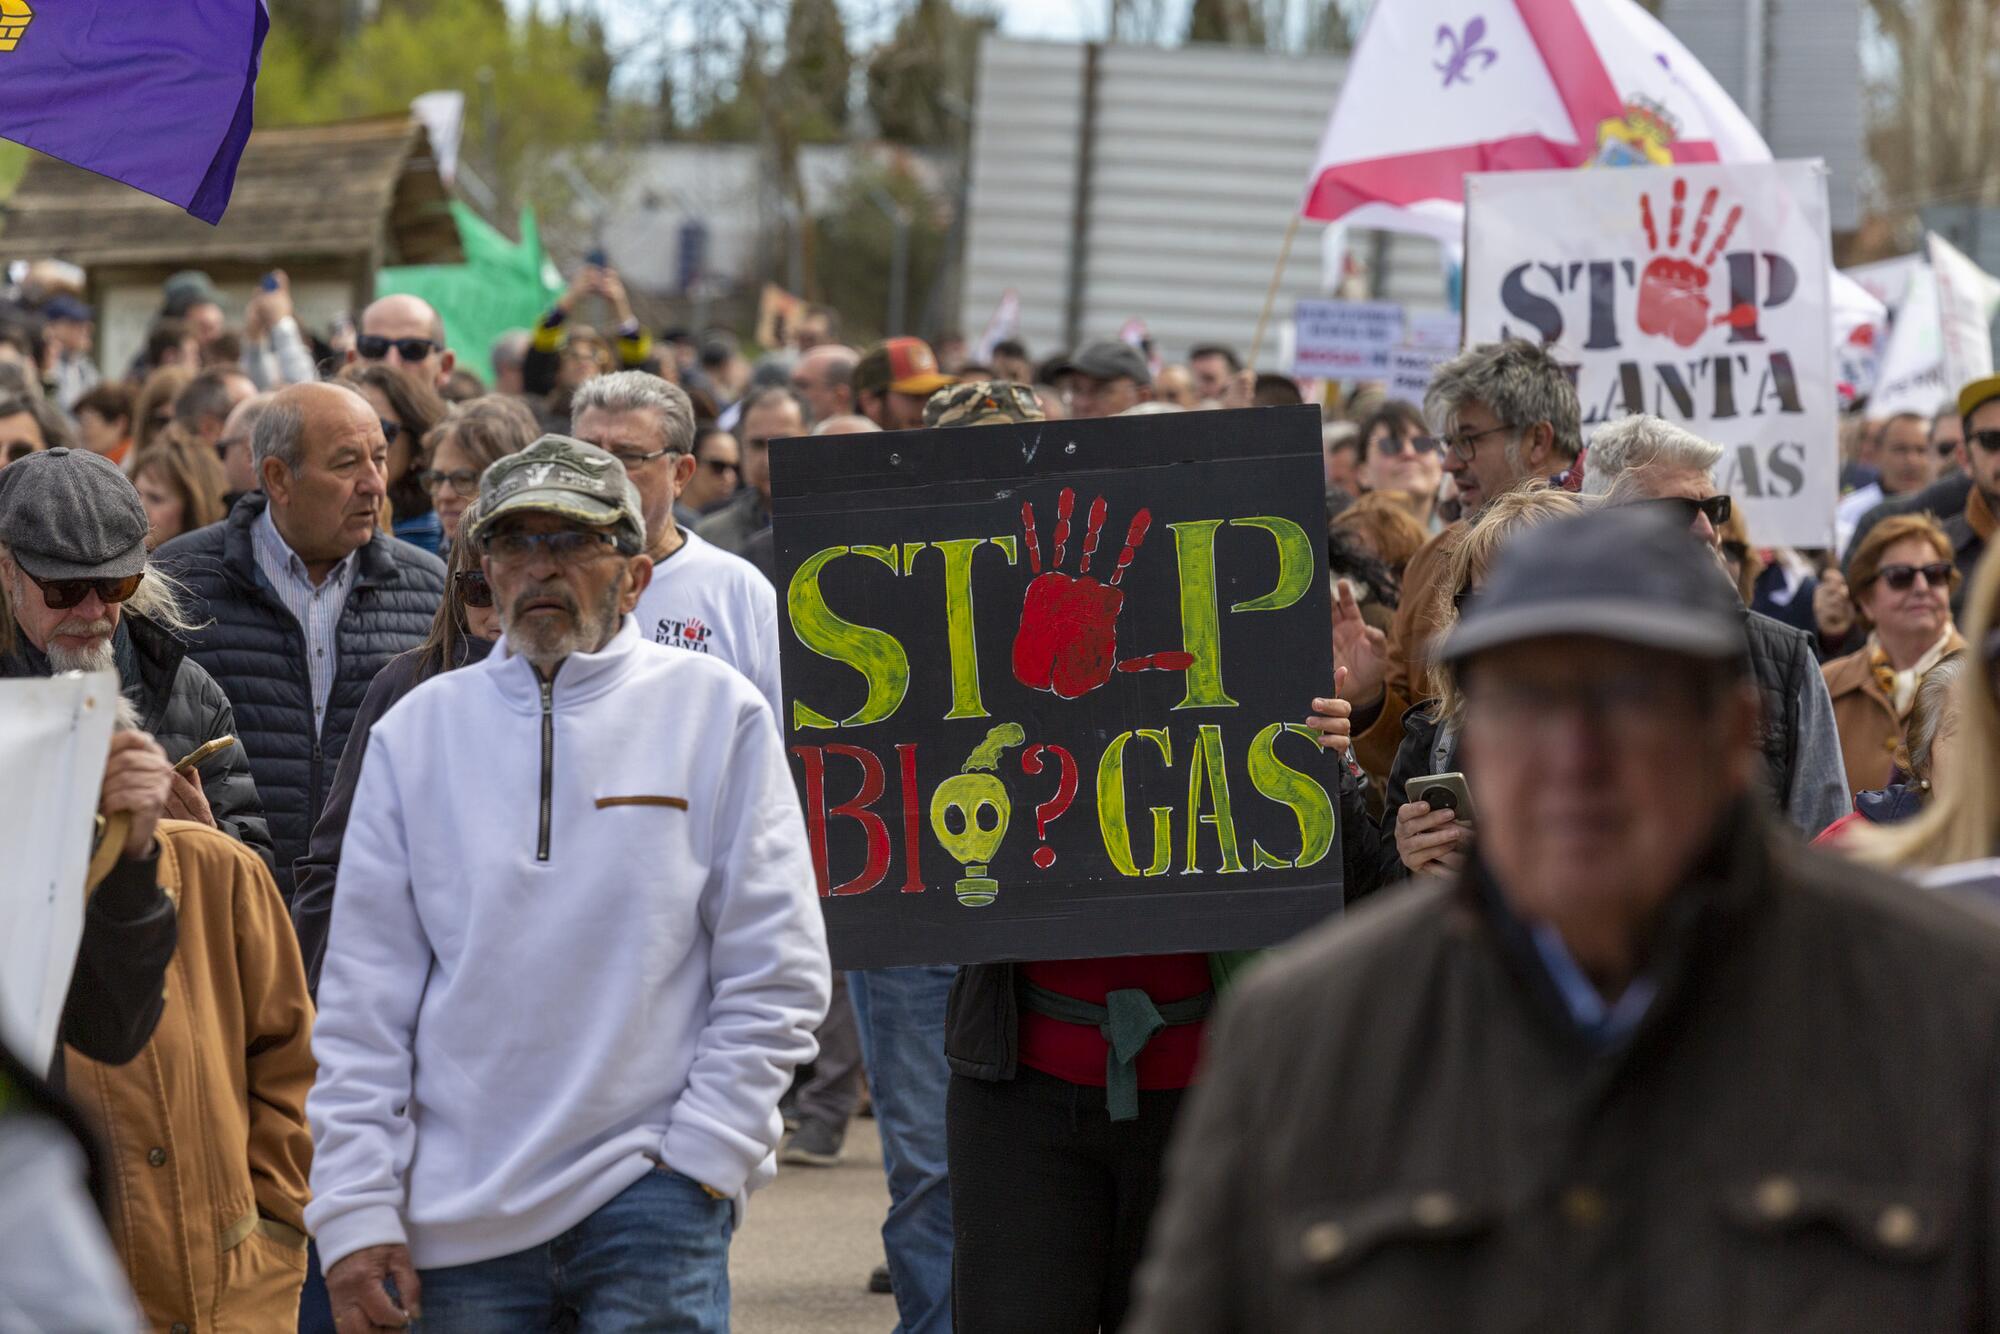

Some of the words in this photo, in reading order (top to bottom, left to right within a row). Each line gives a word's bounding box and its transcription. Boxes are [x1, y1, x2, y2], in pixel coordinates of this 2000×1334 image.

[655, 634, 709, 653] PLANTA
[656, 617, 712, 641] STOP
[788, 490, 1315, 730] STOP
[1096, 722, 1336, 877] GAS
